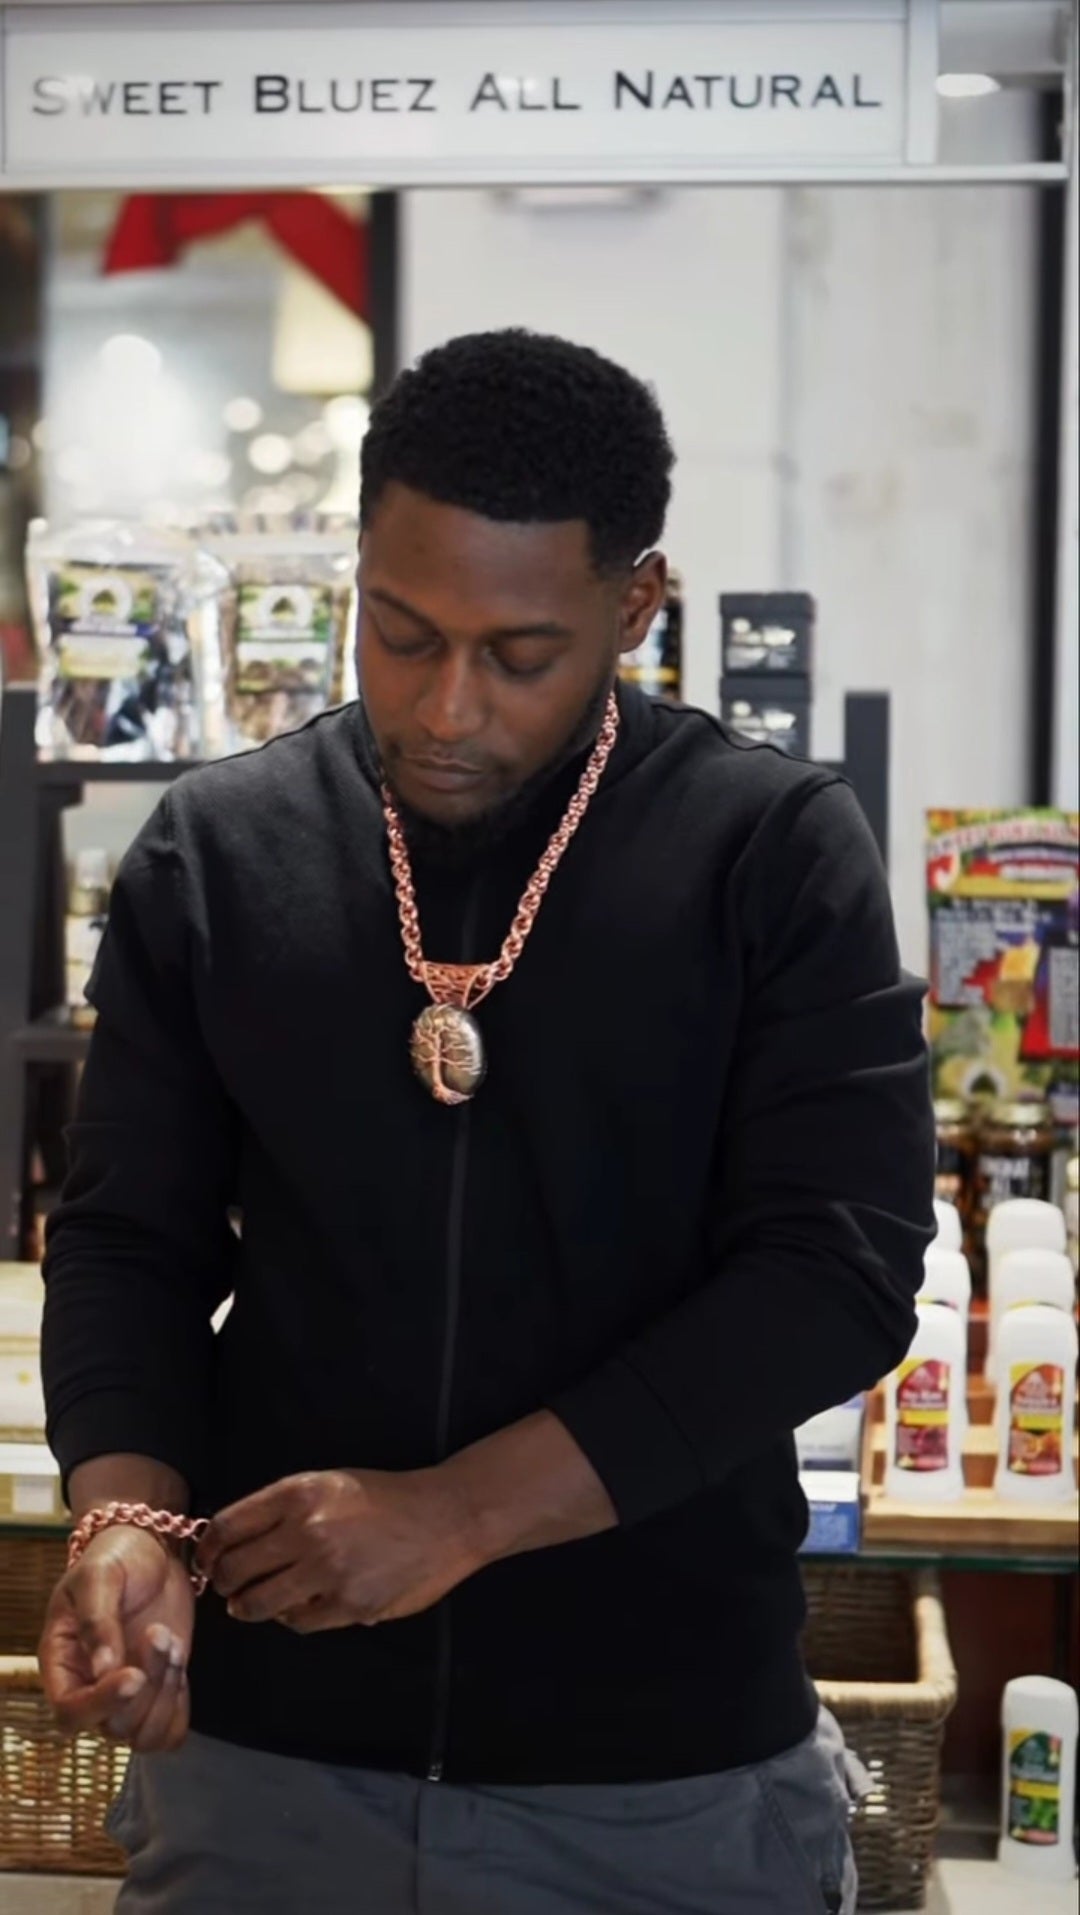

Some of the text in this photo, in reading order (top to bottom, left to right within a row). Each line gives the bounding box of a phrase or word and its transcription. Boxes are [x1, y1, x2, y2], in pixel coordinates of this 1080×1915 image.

[31, 70, 882, 116] SWEET BLUEZ ALL NATURAL
